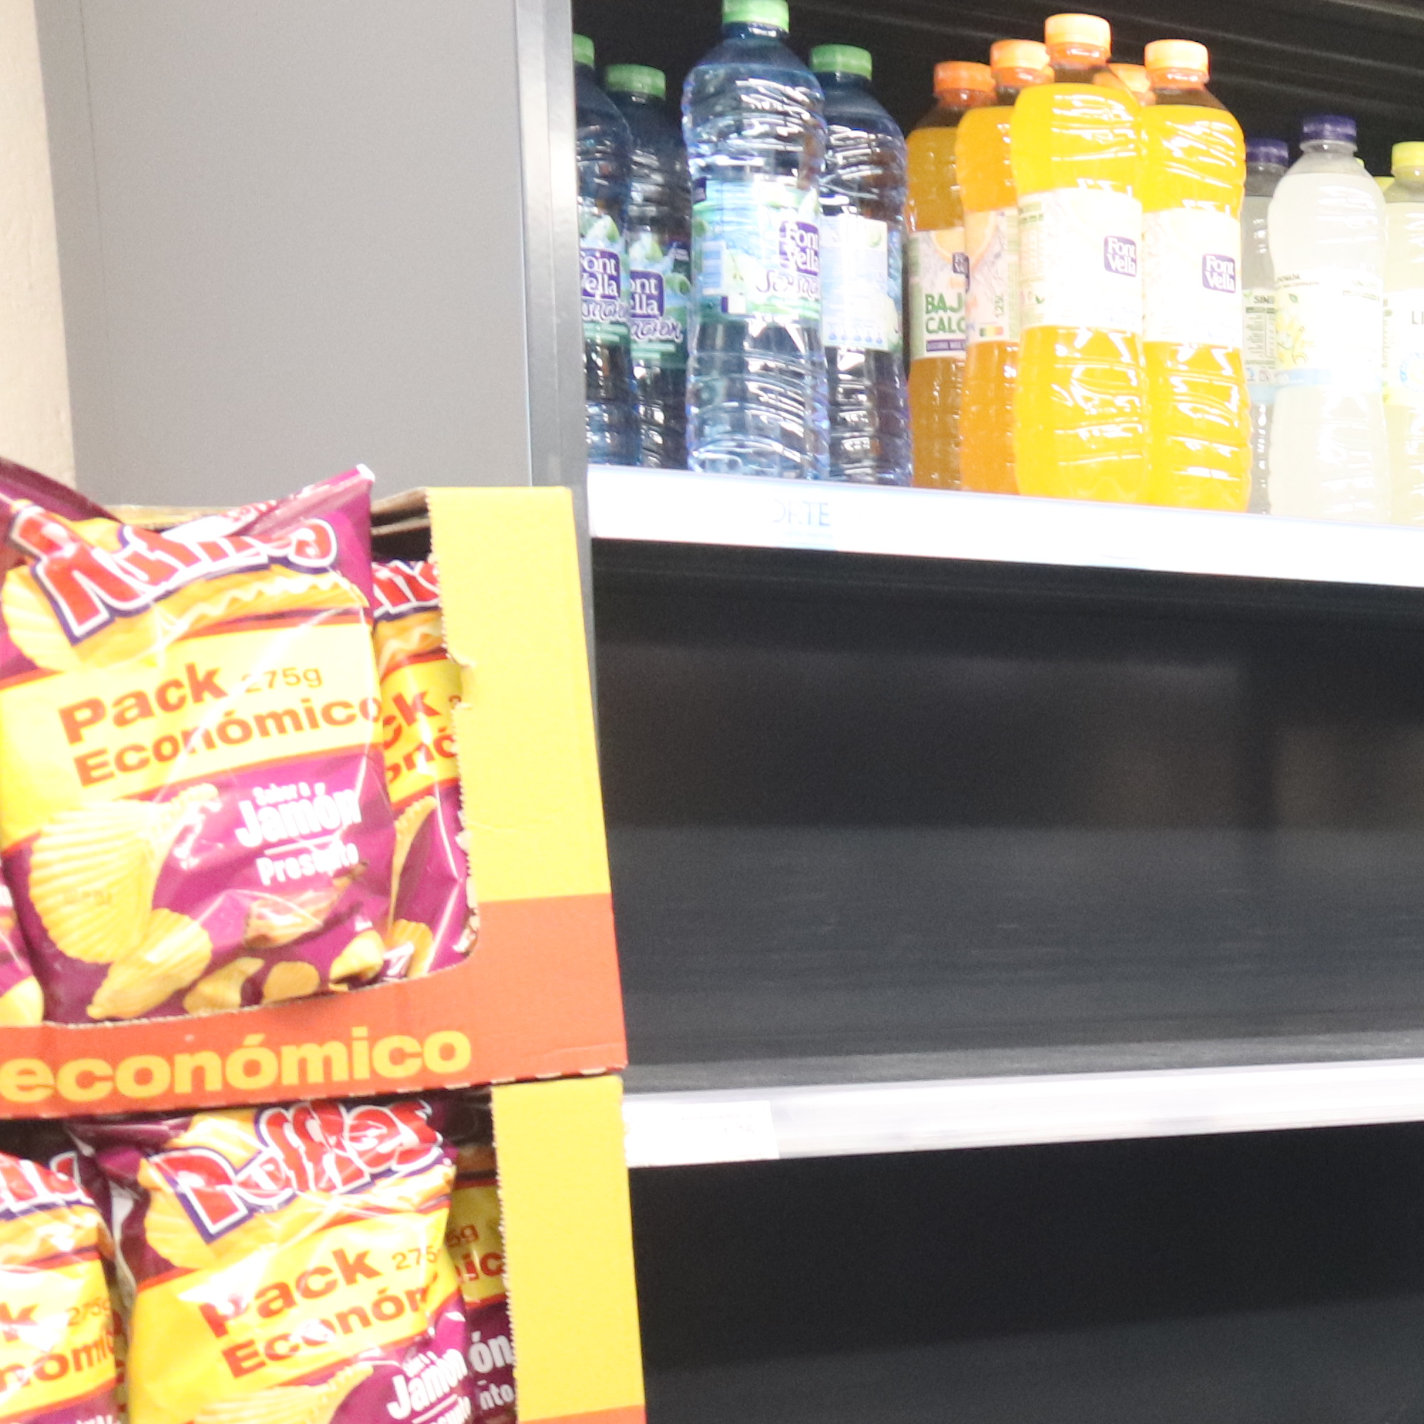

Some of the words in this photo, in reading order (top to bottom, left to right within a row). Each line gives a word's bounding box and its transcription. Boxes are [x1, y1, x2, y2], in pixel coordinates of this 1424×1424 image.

[1107, 254, 1137, 275] Vella
[1205, 271, 1235, 291] Vella
[1206, 256, 1234, 275] Font
[58, 662, 229, 745] Pack
[241, 666, 324, 695] 275g
[74, 697, 383, 787] Económico
[234, 783, 363, 848] Jamón
[0, 1029, 472, 1102] económico
[197, 1247, 383, 1338] Pack
